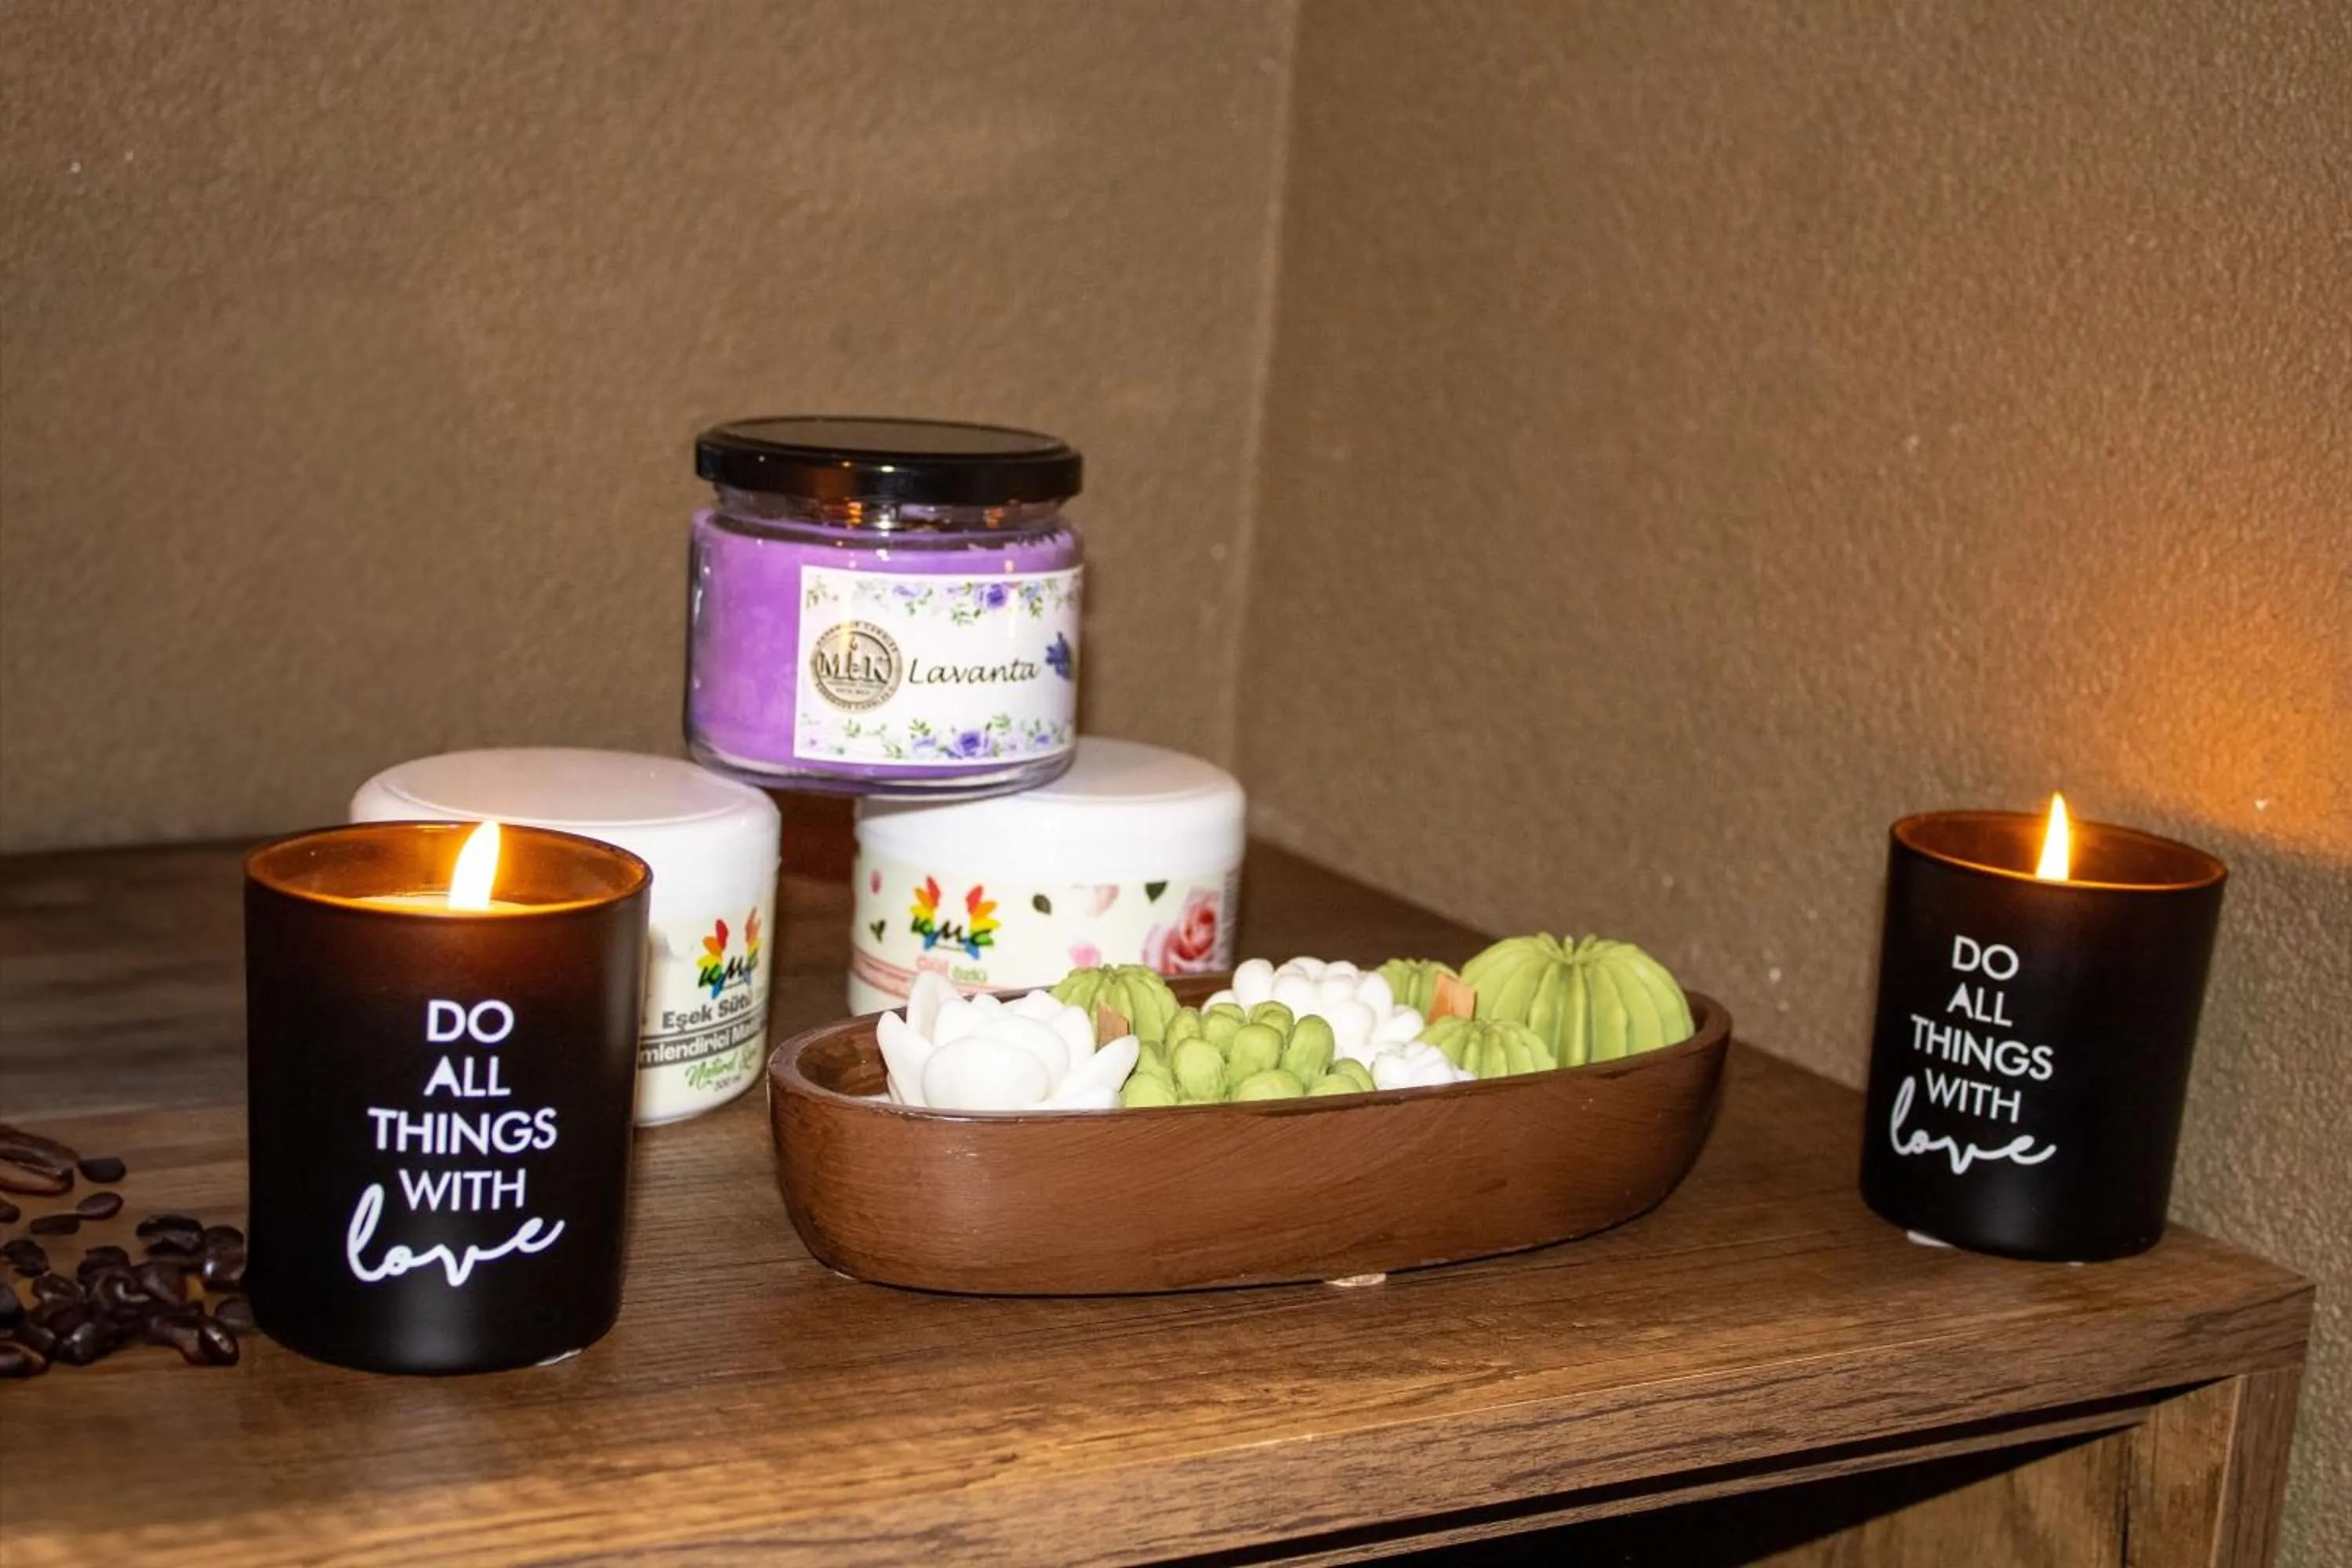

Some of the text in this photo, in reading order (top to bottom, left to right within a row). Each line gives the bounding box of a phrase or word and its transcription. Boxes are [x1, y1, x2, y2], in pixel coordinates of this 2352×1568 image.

[908, 658, 1041, 684] Lavanta
[1952, 935, 2020, 980] DO
[426, 999, 514, 1044] DO
[662, 1004, 713, 1033] Eşek
[1947, 982, 2013, 1027] ALL
[1911, 1014, 2054, 1080] THINGS
[423, 1055, 511, 1098] ALL
[1926, 1069, 2021, 1123] WITH
[367, 1107, 557, 1155] THINGS
[1891, 1076, 2057, 1174] love
[398, 1168, 526, 1212] WITH
[347, 1183, 565, 1287] love
